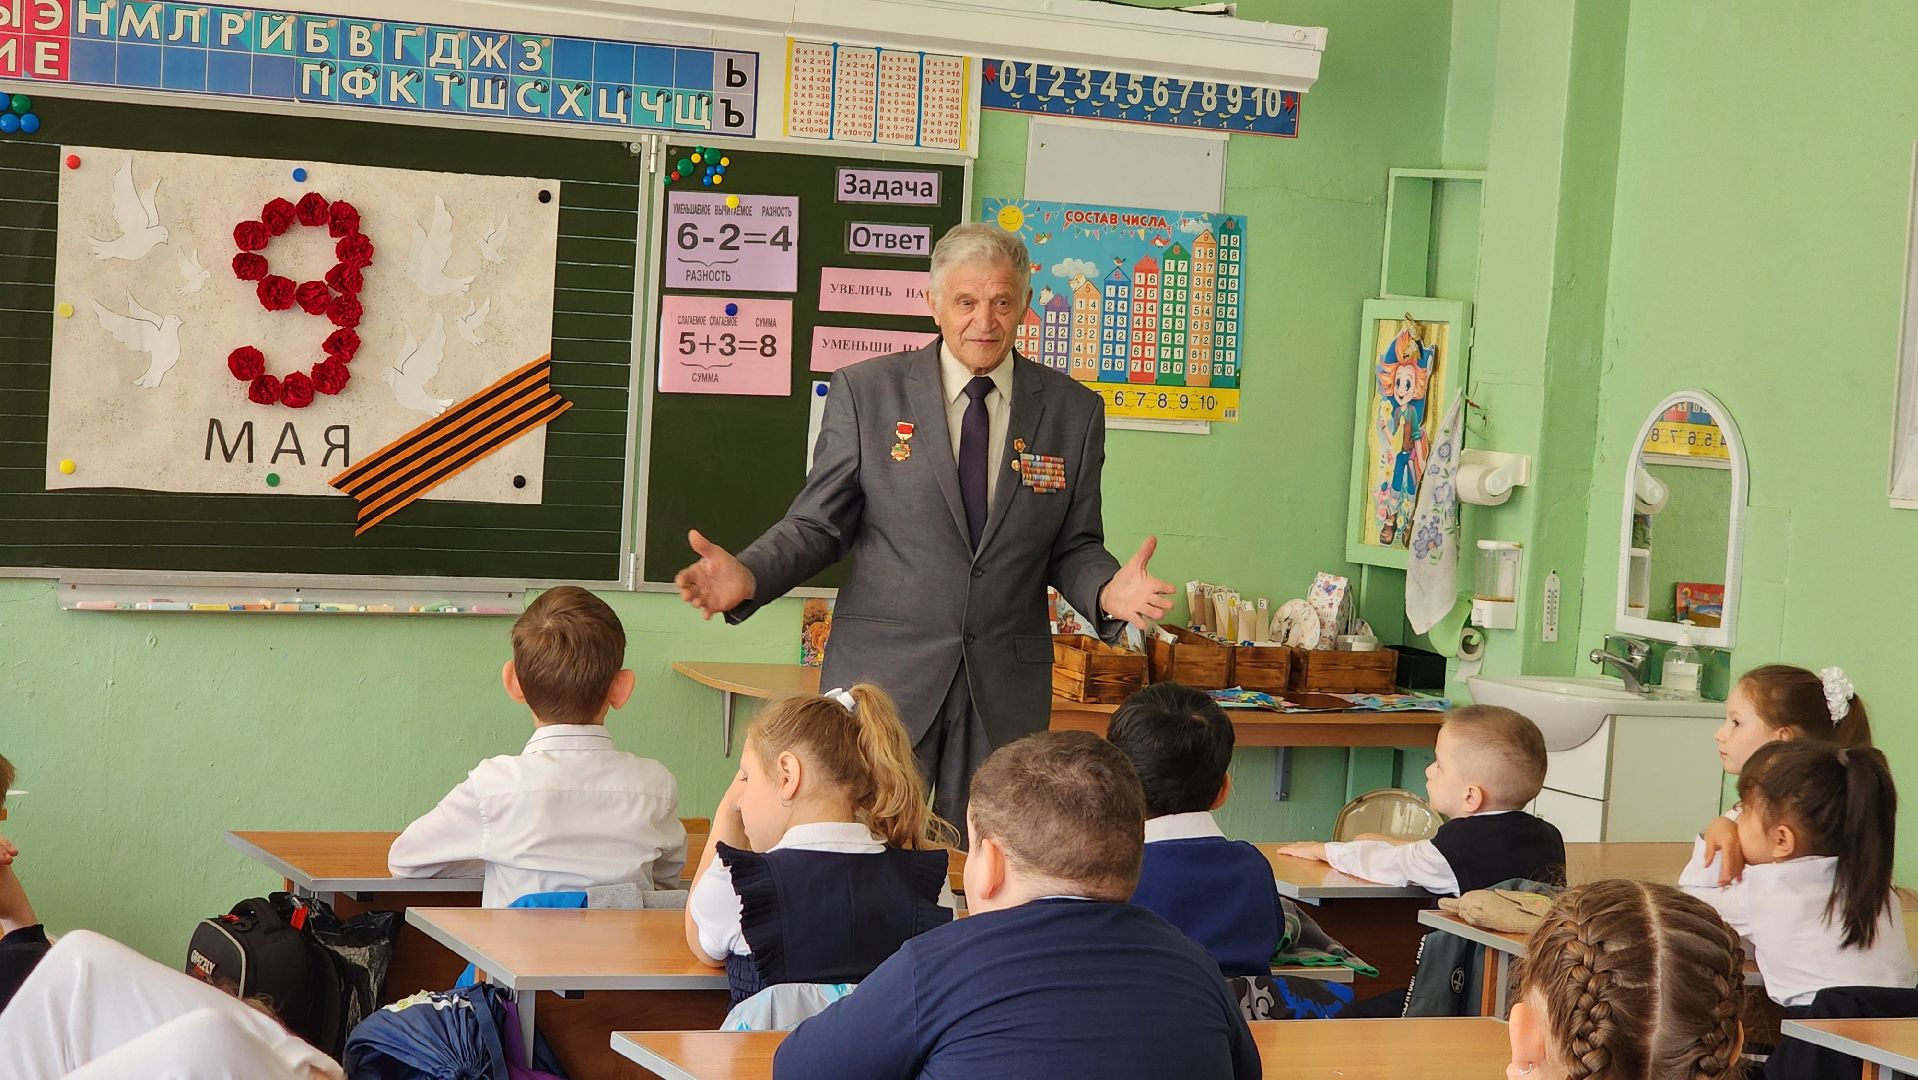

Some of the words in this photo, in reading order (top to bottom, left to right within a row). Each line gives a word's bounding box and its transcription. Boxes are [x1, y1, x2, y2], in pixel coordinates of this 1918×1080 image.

[33, 0, 64, 31] Э
[76, 0, 109, 35] Н
[118, 4, 160, 40] М
[168, 8, 200, 44] Л
[220, 11, 246, 46] Р
[260, 14, 294, 51] Й
[305, 21, 331, 54] Б
[349, 24, 374, 58] В
[394, 28, 417, 60] Г
[428, 32, 462, 70] Д
[470, 35, 509, 70] Ж
[518, 40, 543, 72] З
[725, 57, 748, 88] Ь
[33, 41, 60, 76] Е
[301, 63, 329, 97] П
[340, 67, 377, 99] Ф
[388, 70, 418, 105] К
[433, 74, 460, 107] Т
[468, 76, 506, 111] Ш
[516, 81, 542, 114] С
[556, 83, 584, 118] Х
[598, 87, 627, 125] Ц
[639, 91, 665, 124] Ч
[674, 94, 712, 130] Щ
[719, 98, 745, 128] Ъ
[1000, 61, 1016, 92] 0
[1025, 64, 1038, 94] 1
[1048, 66, 1065, 97] 2
[1074, 69, 1091, 100] 3
[1100, 72, 1117, 102] 4
[1127, 74, 1144, 104] 5
[1152, 78, 1168, 106] 6
[1178, 80, 1194, 109] 7
[1202, 82, 1217, 112] 8
[1227, 85, 1242, 114] 9
[1251, 88, 1281, 118] 10
[843, 174, 933, 200] Задача
[762, 206, 792, 217] РАЗНОСТЬ
[1064, 210, 1118, 227] СОСТАВ
[1122, 213, 1168, 228] ЧИСЛА
[852, 226, 925, 250] Ответ
[686, 269, 731, 282] РАЗНОСТЬ
[228, 192, 374, 408] 9
[830, 283, 892, 298] УВЕЛИЧЬ
[756, 317, 776, 328] СУММА
[822, 338, 892, 352] УМЕНЬШИ
[692, 372, 719, 384] СУММА
[1114, 391, 1124, 406] 6
[1136, 392, 1146, 406] 7
[1158, 394, 1167, 408] 8
[1180, 394, 1188, 409] 9
[1200, 396, 1215, 410] 10
[204, 418, 351, 468] МАЯ
[191, 950, 216, 975] GRIZZLY
